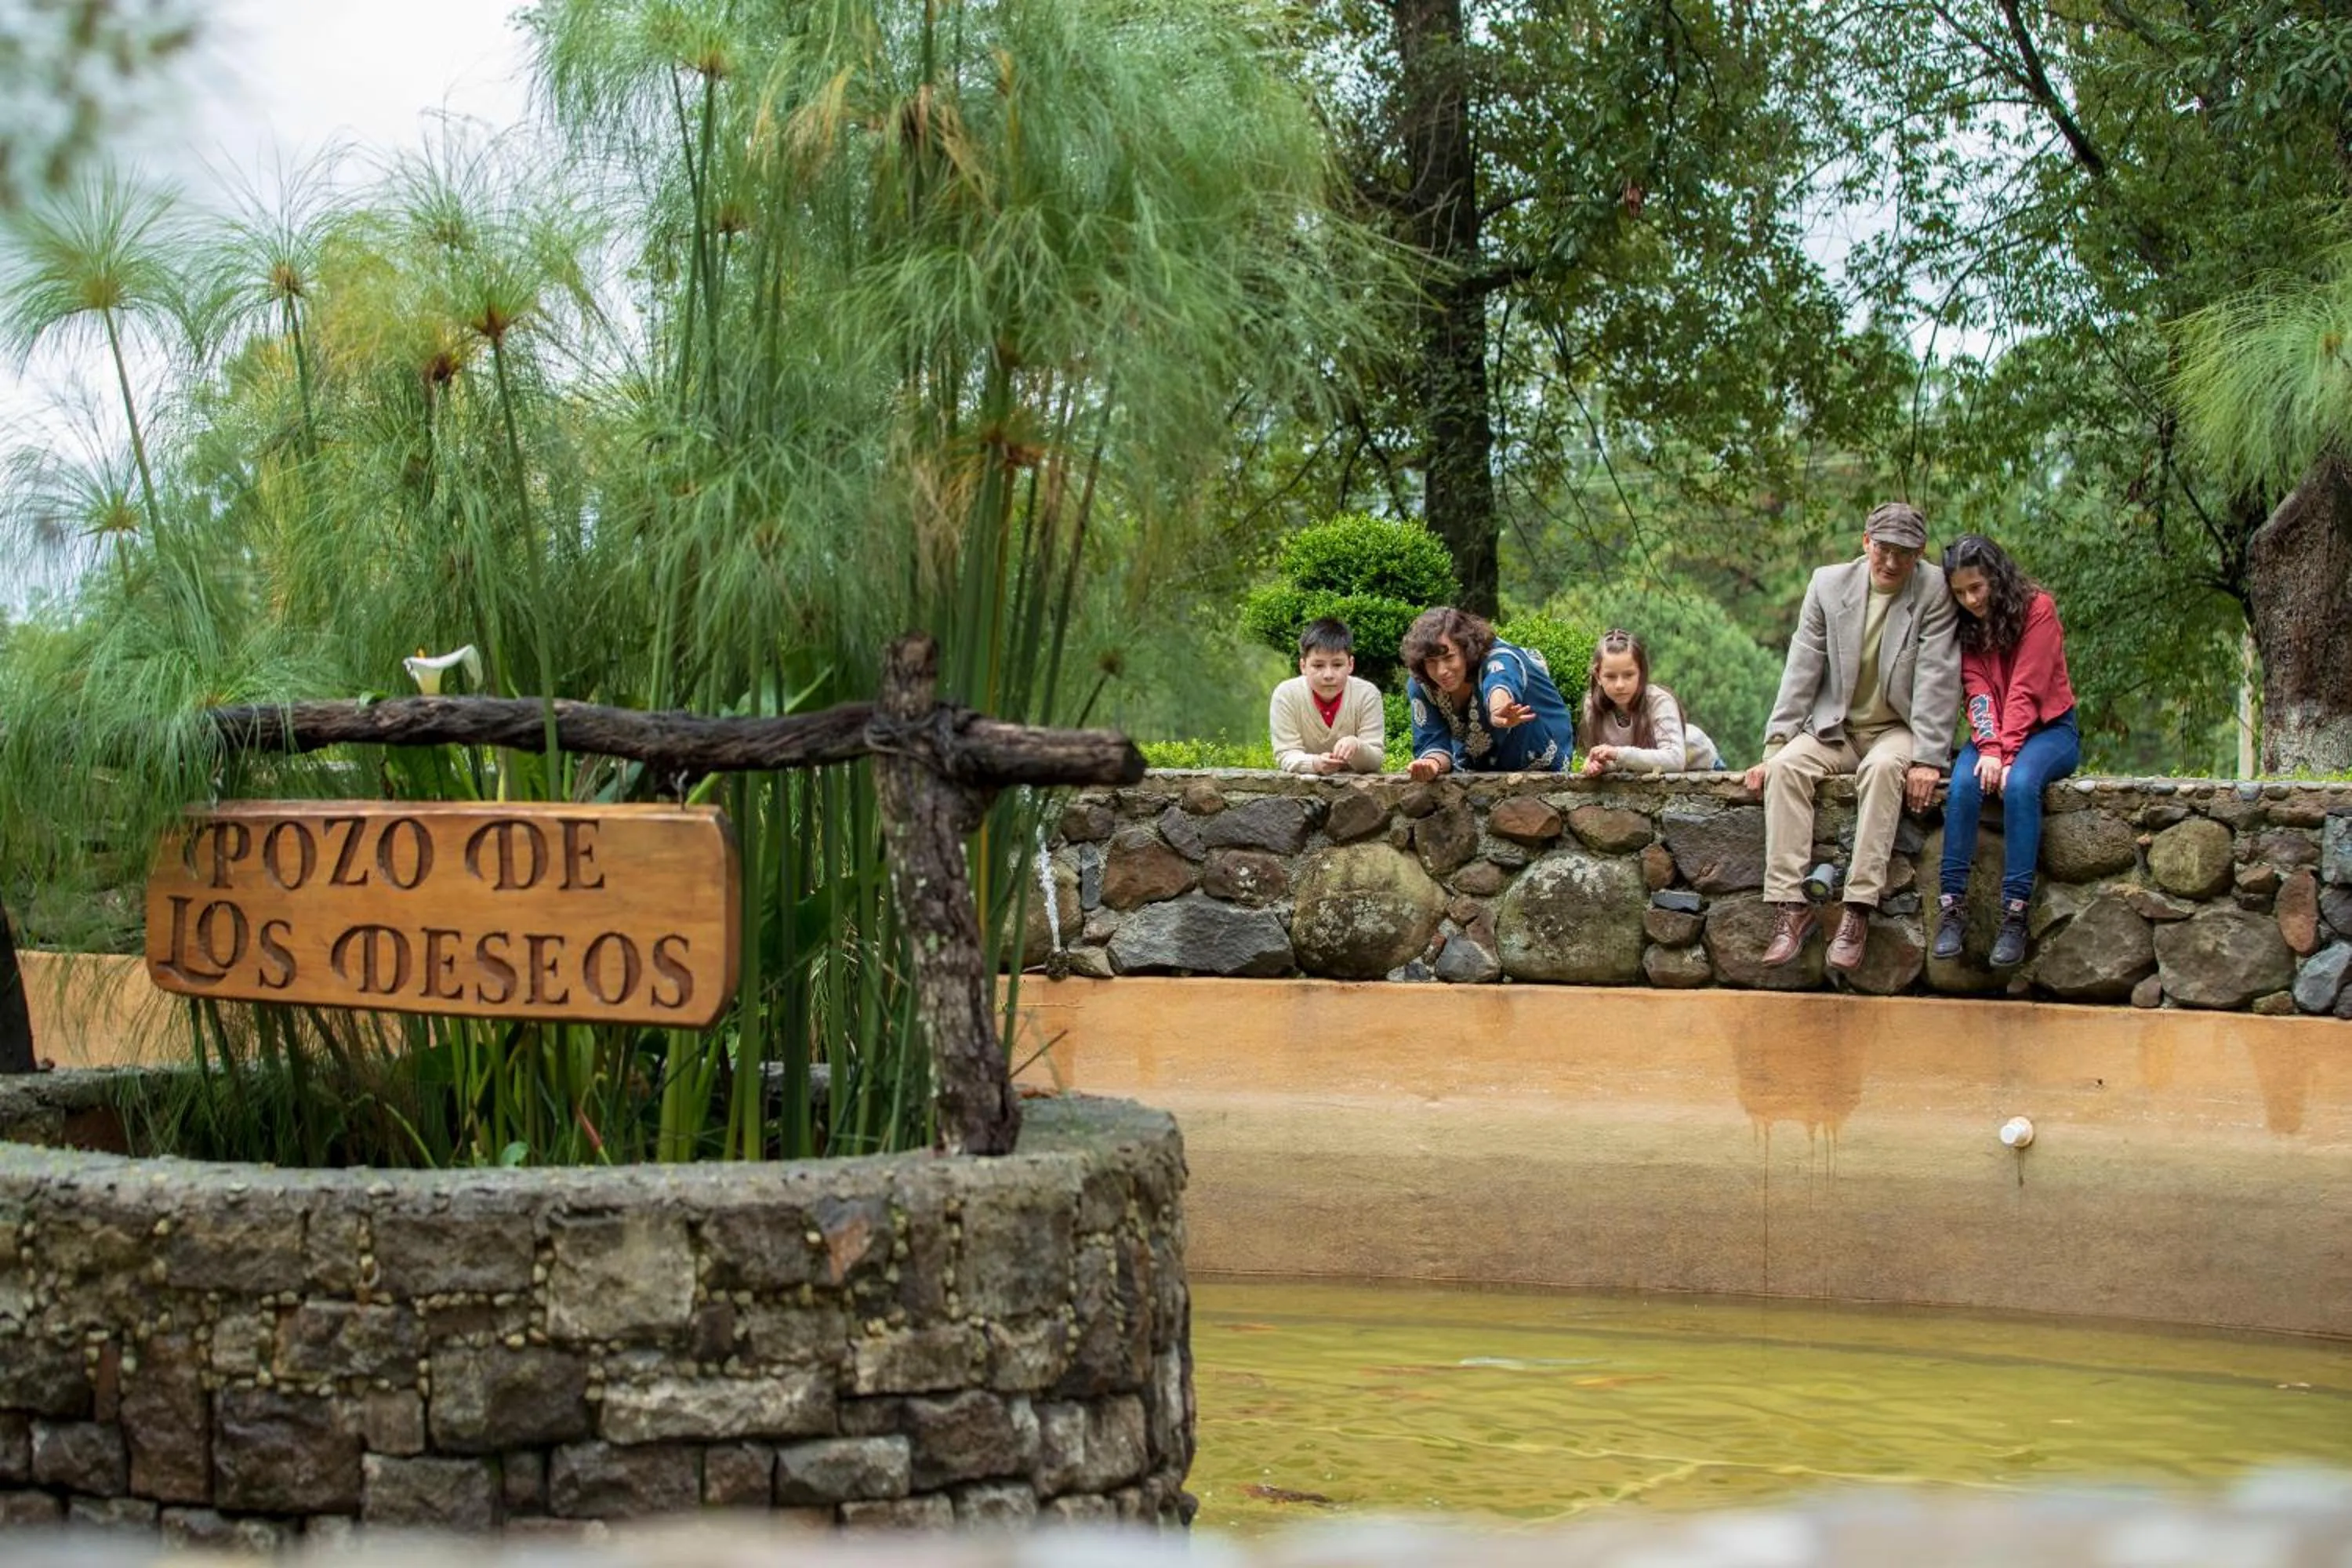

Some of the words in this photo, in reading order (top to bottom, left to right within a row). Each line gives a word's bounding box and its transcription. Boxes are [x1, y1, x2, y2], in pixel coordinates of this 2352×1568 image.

[183, 818, 434, 891] POZO
[465, 818, 605, 891] DE
[157, 895, 297, 989] LOS
[330, 924, 695, 1009] DESEOS
